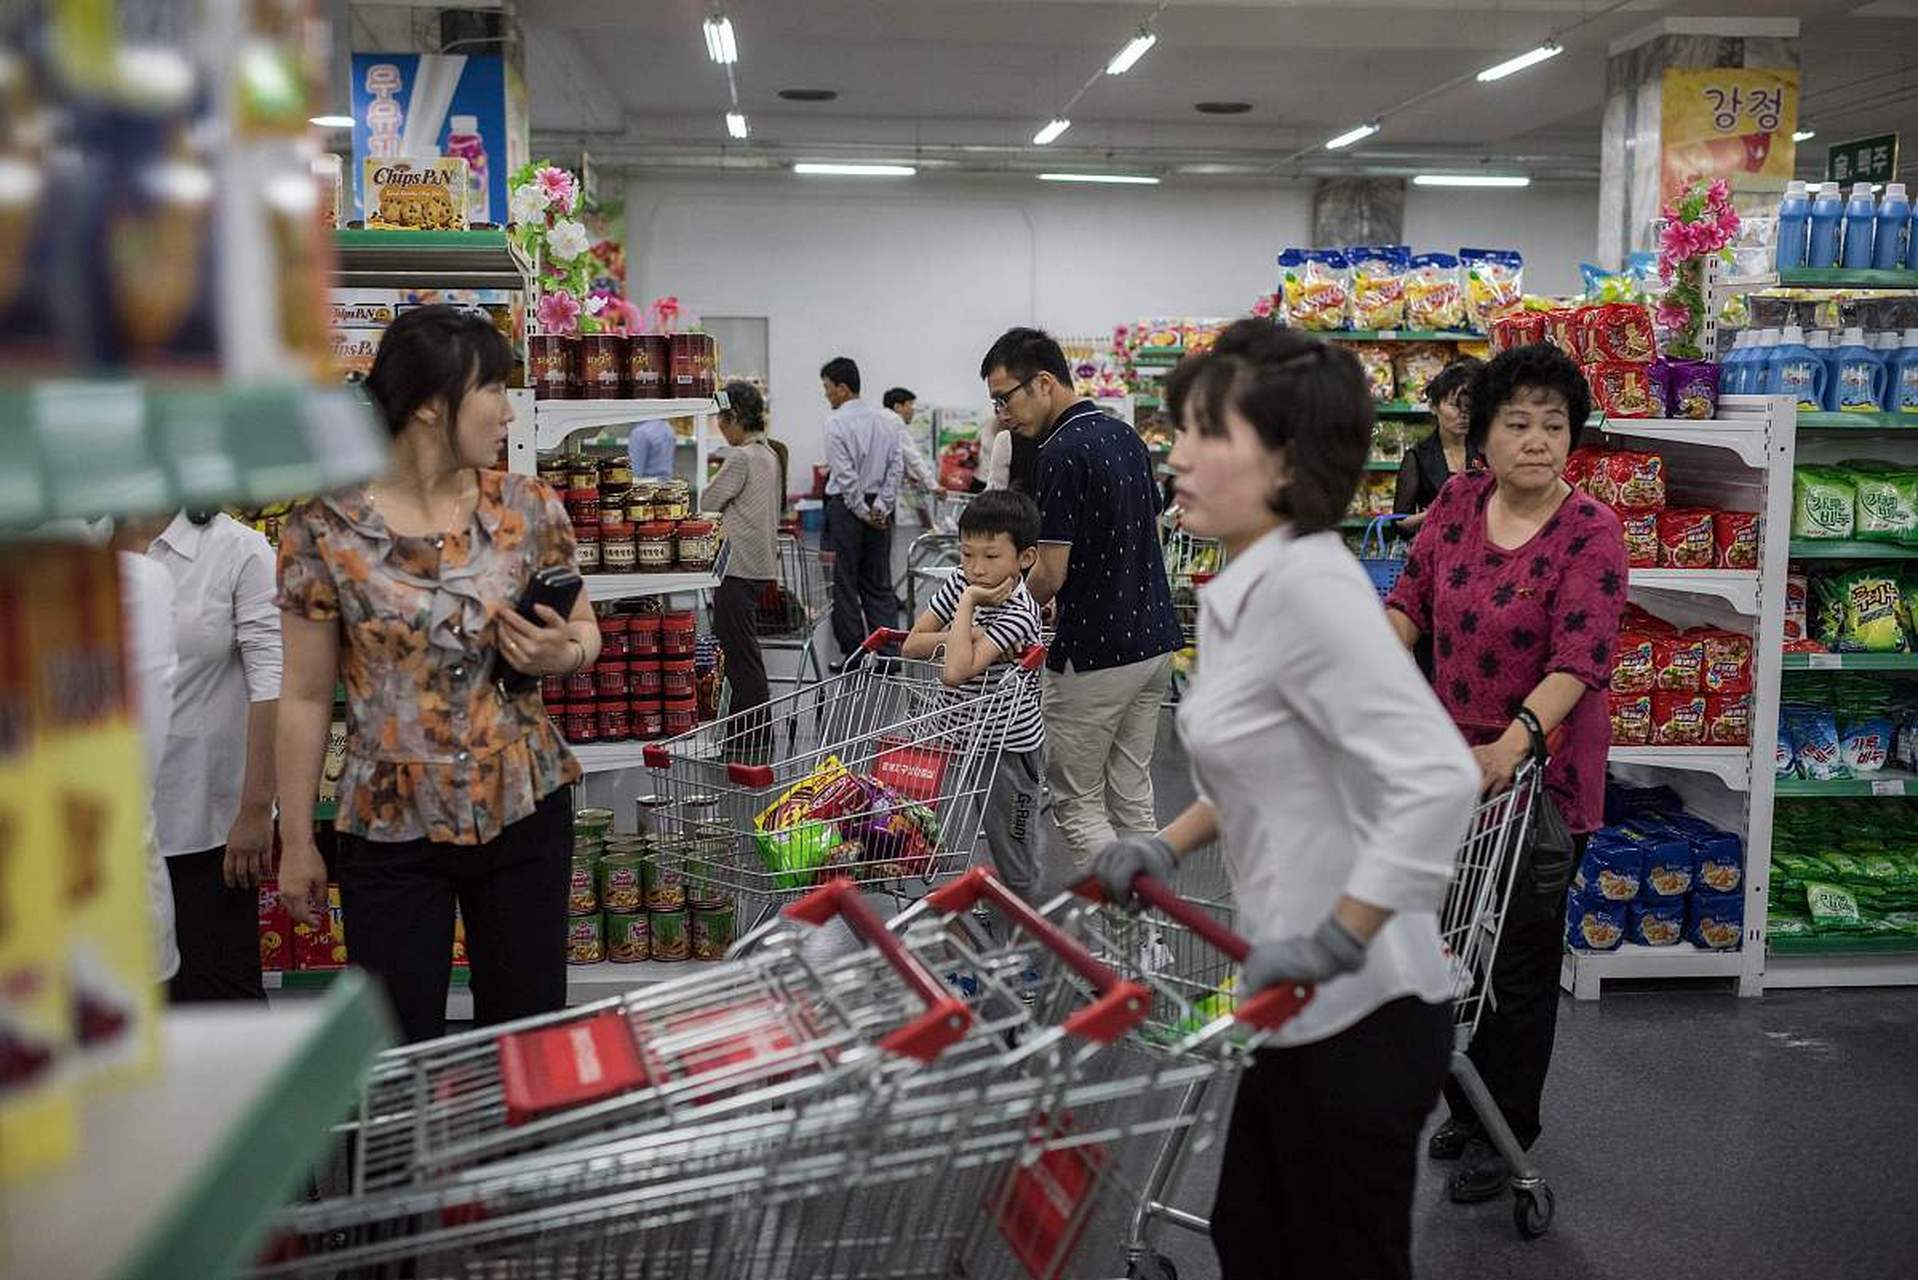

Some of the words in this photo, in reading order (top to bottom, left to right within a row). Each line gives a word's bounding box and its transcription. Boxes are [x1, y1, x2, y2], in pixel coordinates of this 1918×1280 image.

[1704, 87, 1783, 129] 강정
[373, 167, 421, 187] Chips
[1820, 511, 1850, 526] 비누
